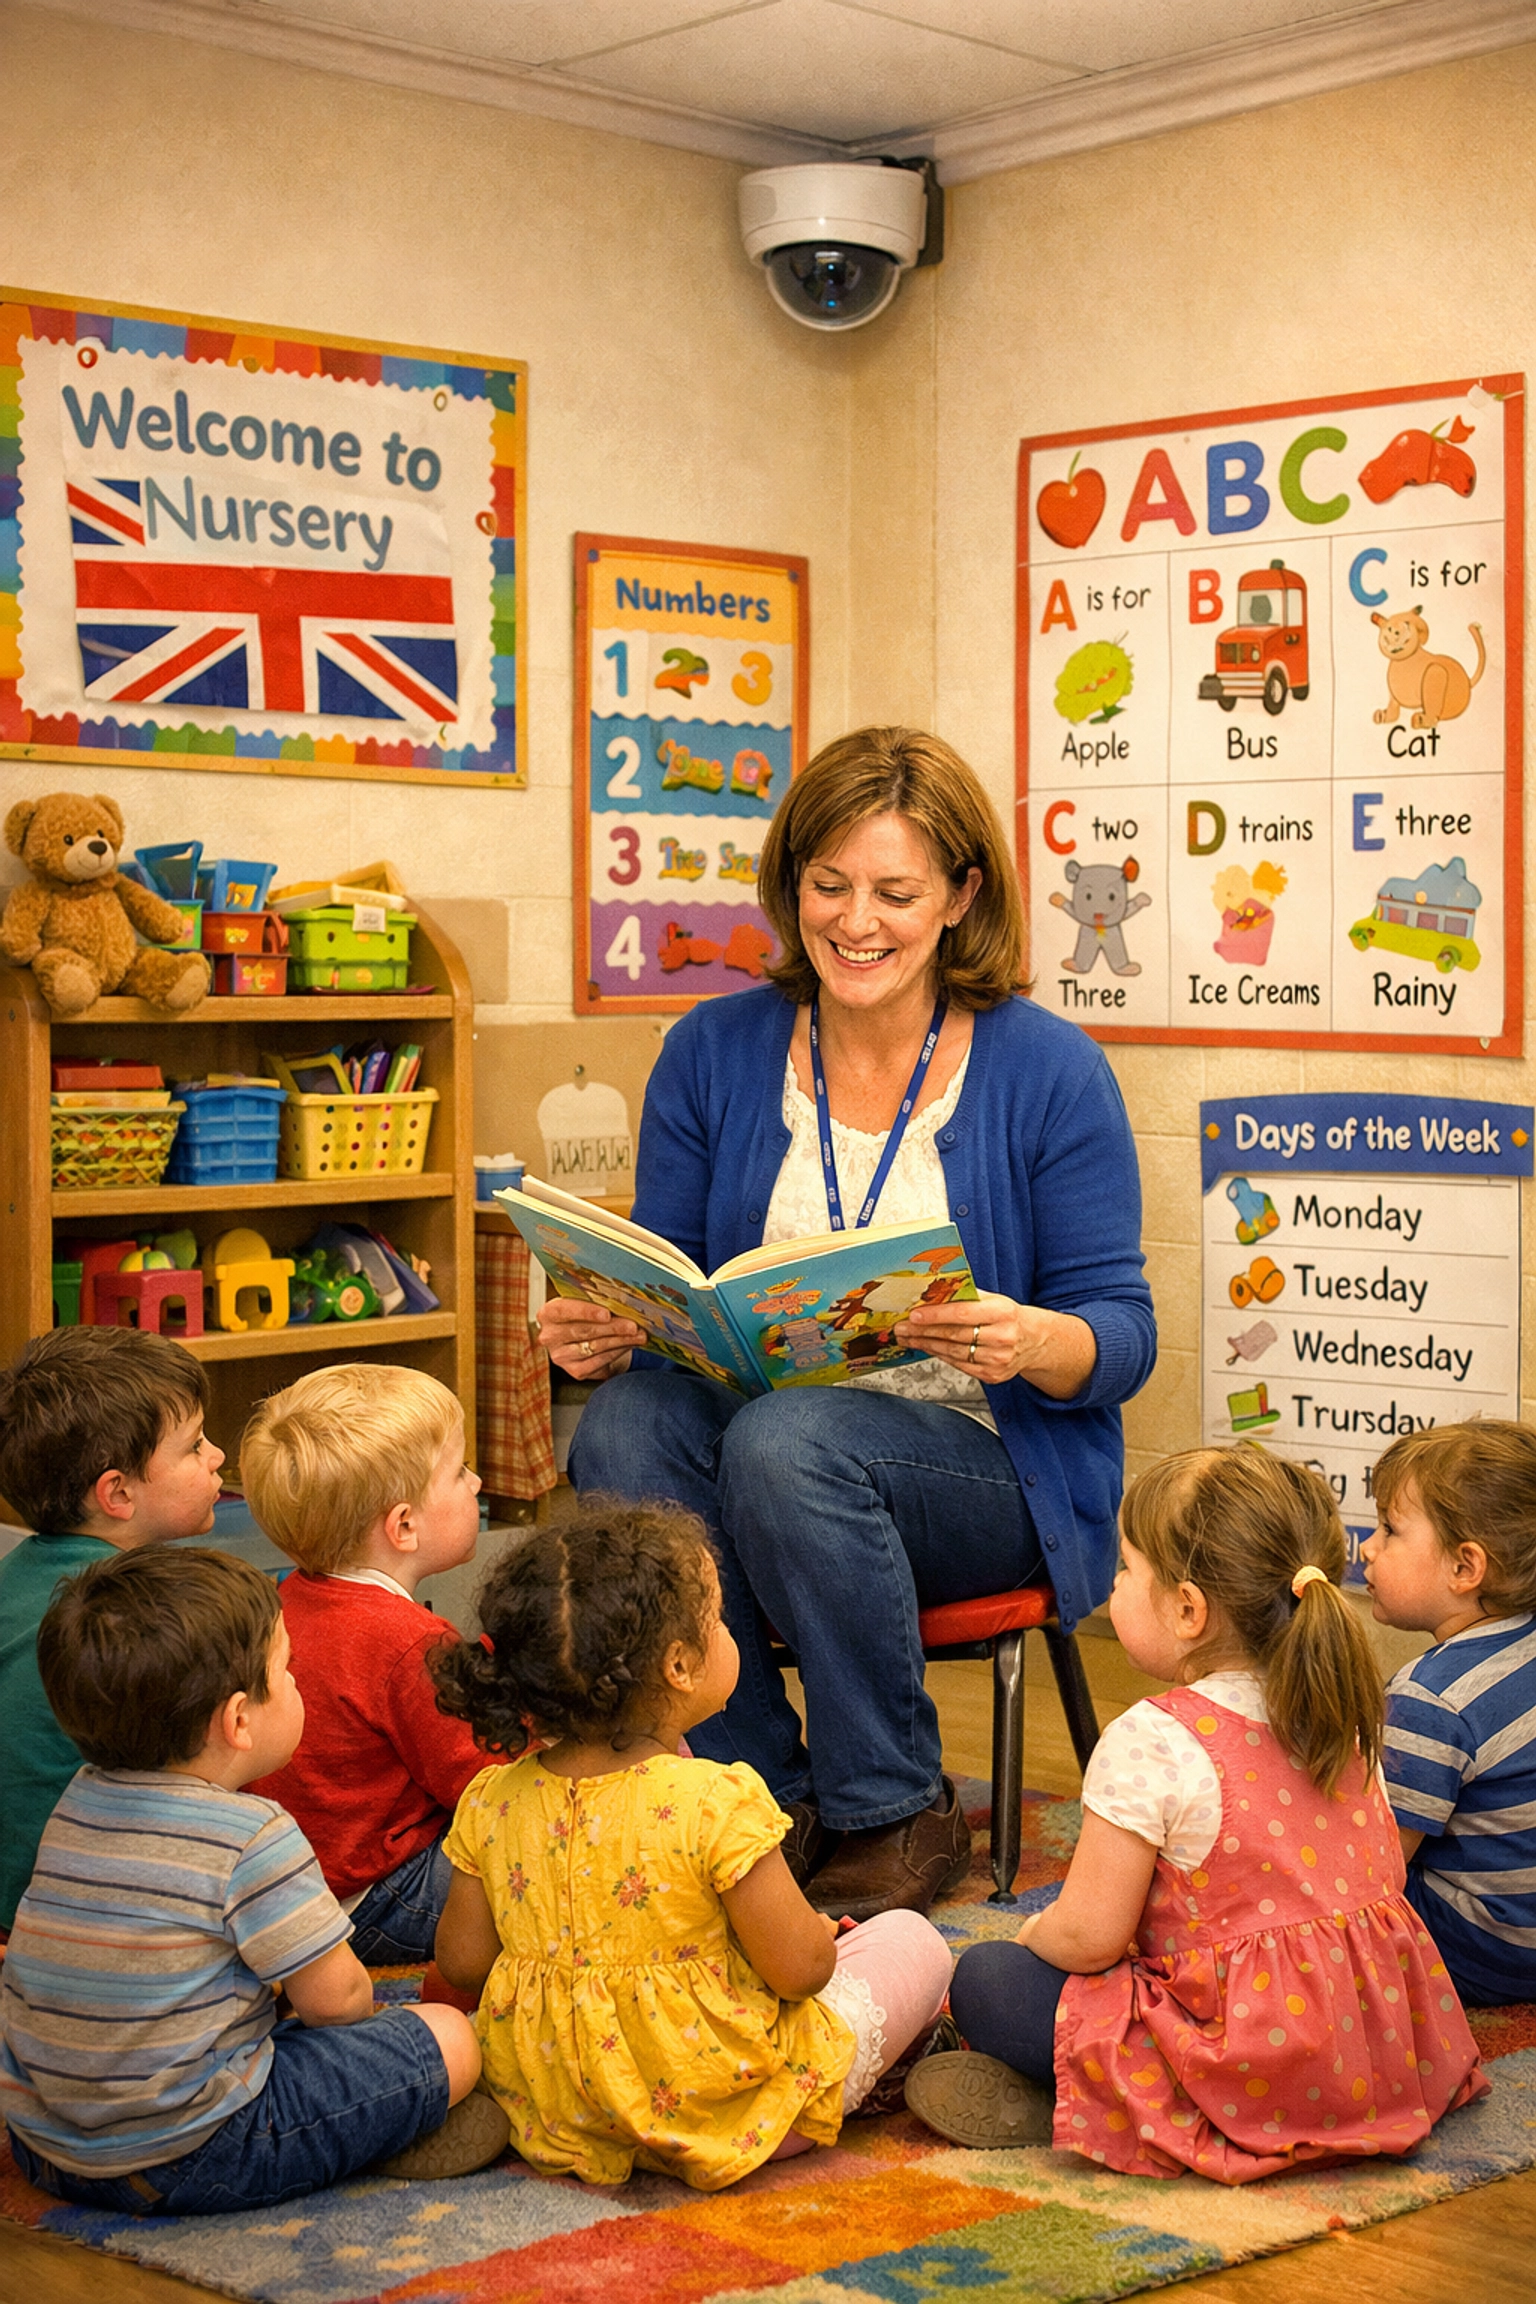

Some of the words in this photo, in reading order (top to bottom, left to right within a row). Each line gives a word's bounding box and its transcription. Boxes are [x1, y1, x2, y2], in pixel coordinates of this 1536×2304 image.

[62, 384, 362, 477] Welcome
[383, 431, 442, 492] to
[1120, 426, 1350, 543] ABC
[144, 475, 393, 572] Nursery
[615, 577, 771, 623] Numbers
[1188, 568, 1223, 624] B
[1348, 547, 1389, 606] C
[1409, 560, 1430, 588] is
[1440, 559, 1487, 586] for
[1040, 579, 1078, 634] A
[1086, 584, 1104, 611] is
[1112, 584, 1151, 609] for
[604, 641, 628, 697] 1
[606, 736, 642, 799] 2
[1061, 731, 1130, 768] Apple
[1226, 727, 1278, 760] Bus
[1387, 725, 1441, 758] Cat
[1043, 800, 1076, 855] C
[1091, 816, 1138, 841] two
[1187, 800, 1226, 855] D
[1239, 815, 1313, 843] trains
[1353, 793, 1385, 851] E
[1396, 805, 1472, 836] three
[607, 826, 641, 886] 3
[605, 915, 646, 980] 4
[1058, 979, 1126, 1008] Three
[1188, 974, 1227, 1004] Ice
[1237, 974, 1320, 1006] Creams
[1373, 971, 1457, 1016] Rainy
[1235, 1113, 1316, 1158] Days
[1326, 1115, 1357, 1151] of
[1363, 1115, 1411, 1151] the
[1419, 1116, 1501, 1155] Week
[1292, 1195, 1422, 1241] Monday
[1292, 1264, 1428, 1313] Tuesday
[1292, 1329, 1473, 1382] Wednesday
